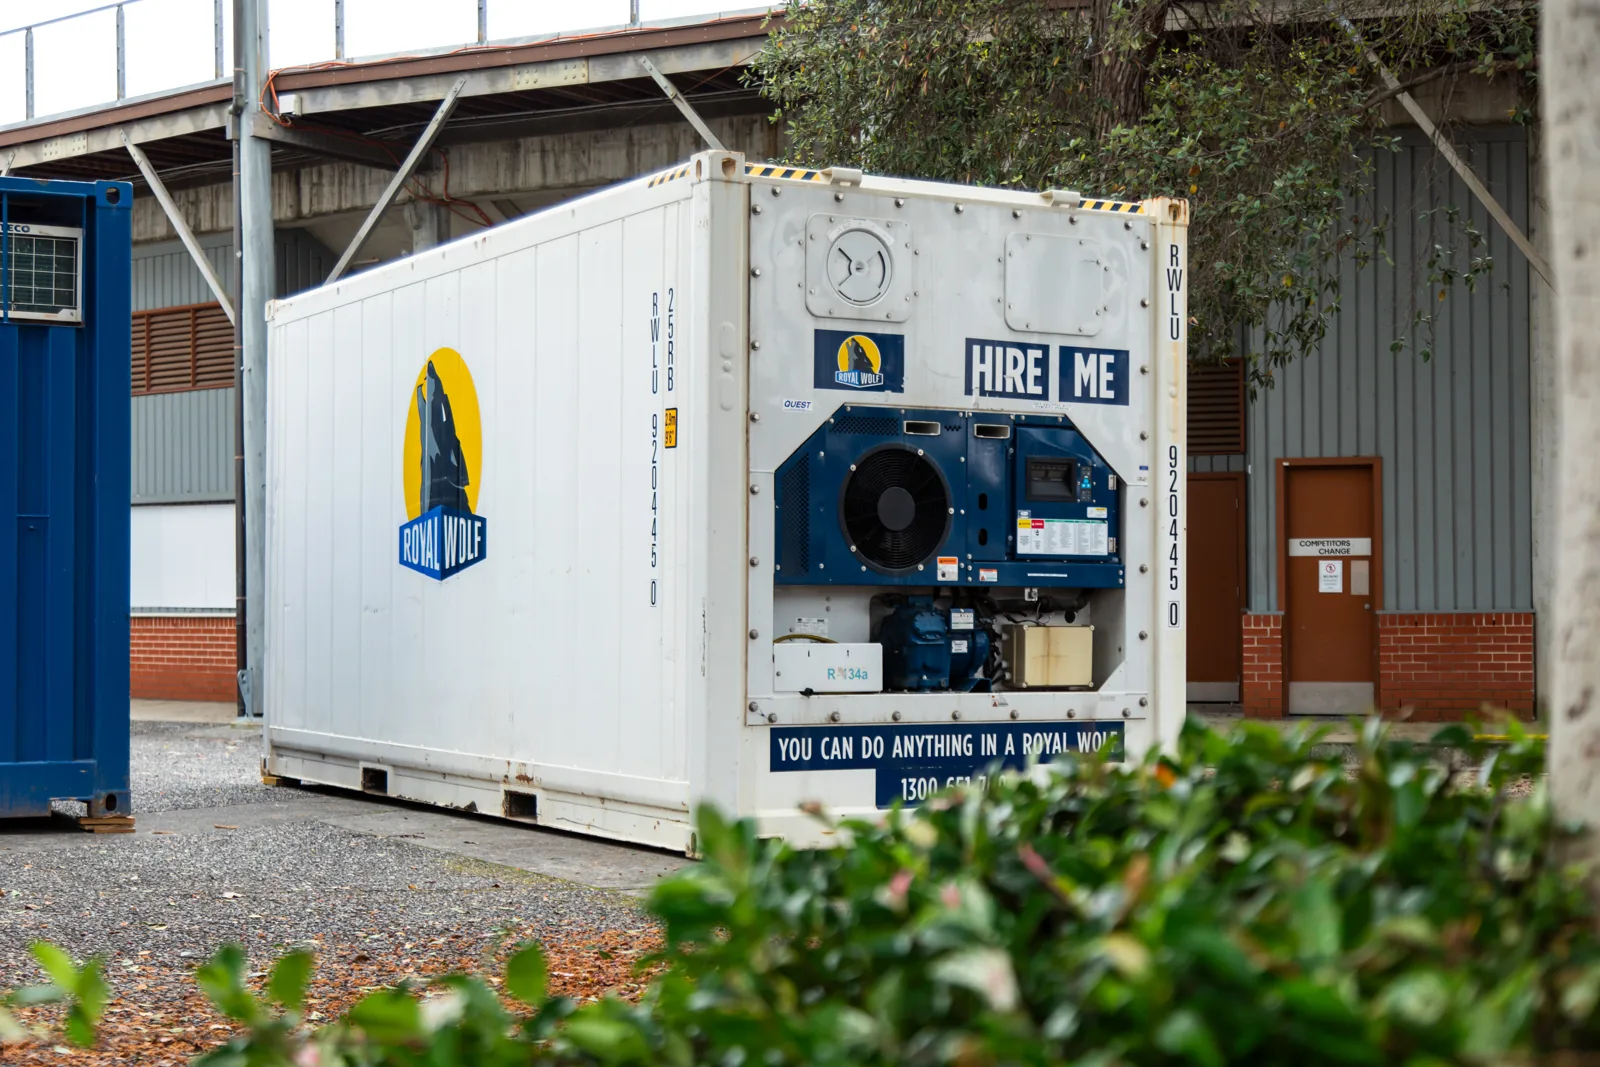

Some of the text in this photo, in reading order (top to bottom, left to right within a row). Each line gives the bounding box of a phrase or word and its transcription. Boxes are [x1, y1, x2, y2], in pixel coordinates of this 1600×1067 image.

[1, 224, 30, 233] ECO
[650, 292, 660, 395] RWLU
[838, 371, 880, 385] ROYAL WOLF
[971, 344, 1115, 399] HIRE ME
[784, 400, 812, 409] QUEST
[1166, 244, 1183, 626] RWLU 920445 0
[403, 514, 482, 571] ROYAL WOLF
[650, 580, 657, 606] 0
[778, 737, 812, 761] YOU
[820, 736, 853, 760] CAN
[861, 735, 884, 759] DO
[891, 733, 973, 758] ANYTHING
[981, 733, 997, 756] IN
[1004, 733, 1016, 756] A
[1022, 732, 1070, 755] ROYAL
[900, 777, 938, 800] 1300
